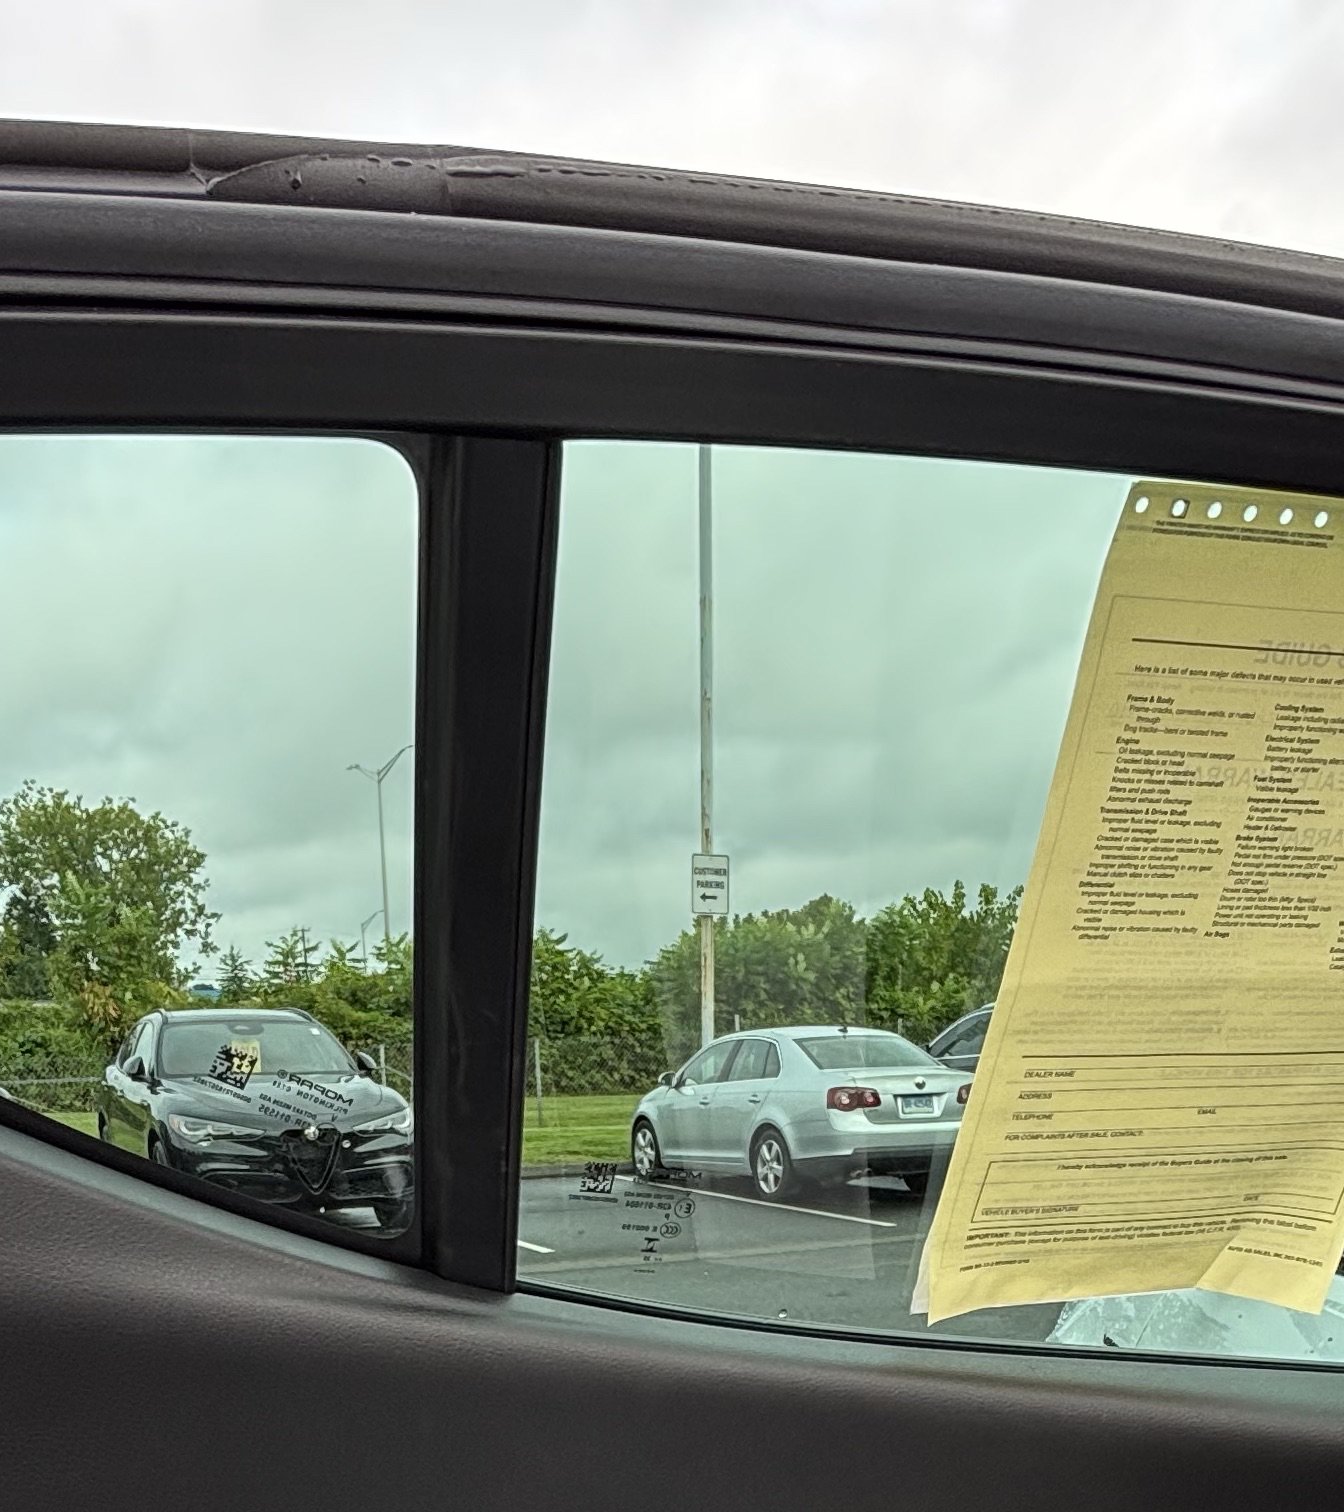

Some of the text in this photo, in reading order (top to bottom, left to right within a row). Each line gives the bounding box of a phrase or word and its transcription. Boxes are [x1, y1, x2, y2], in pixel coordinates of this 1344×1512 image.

[1157, 696, 1174, 705] Body
[1116, 737, 1140, 746] Engine
[693, 867, 727, 876] CUSTOMER
[696, 880, 725, 889] PARKING
